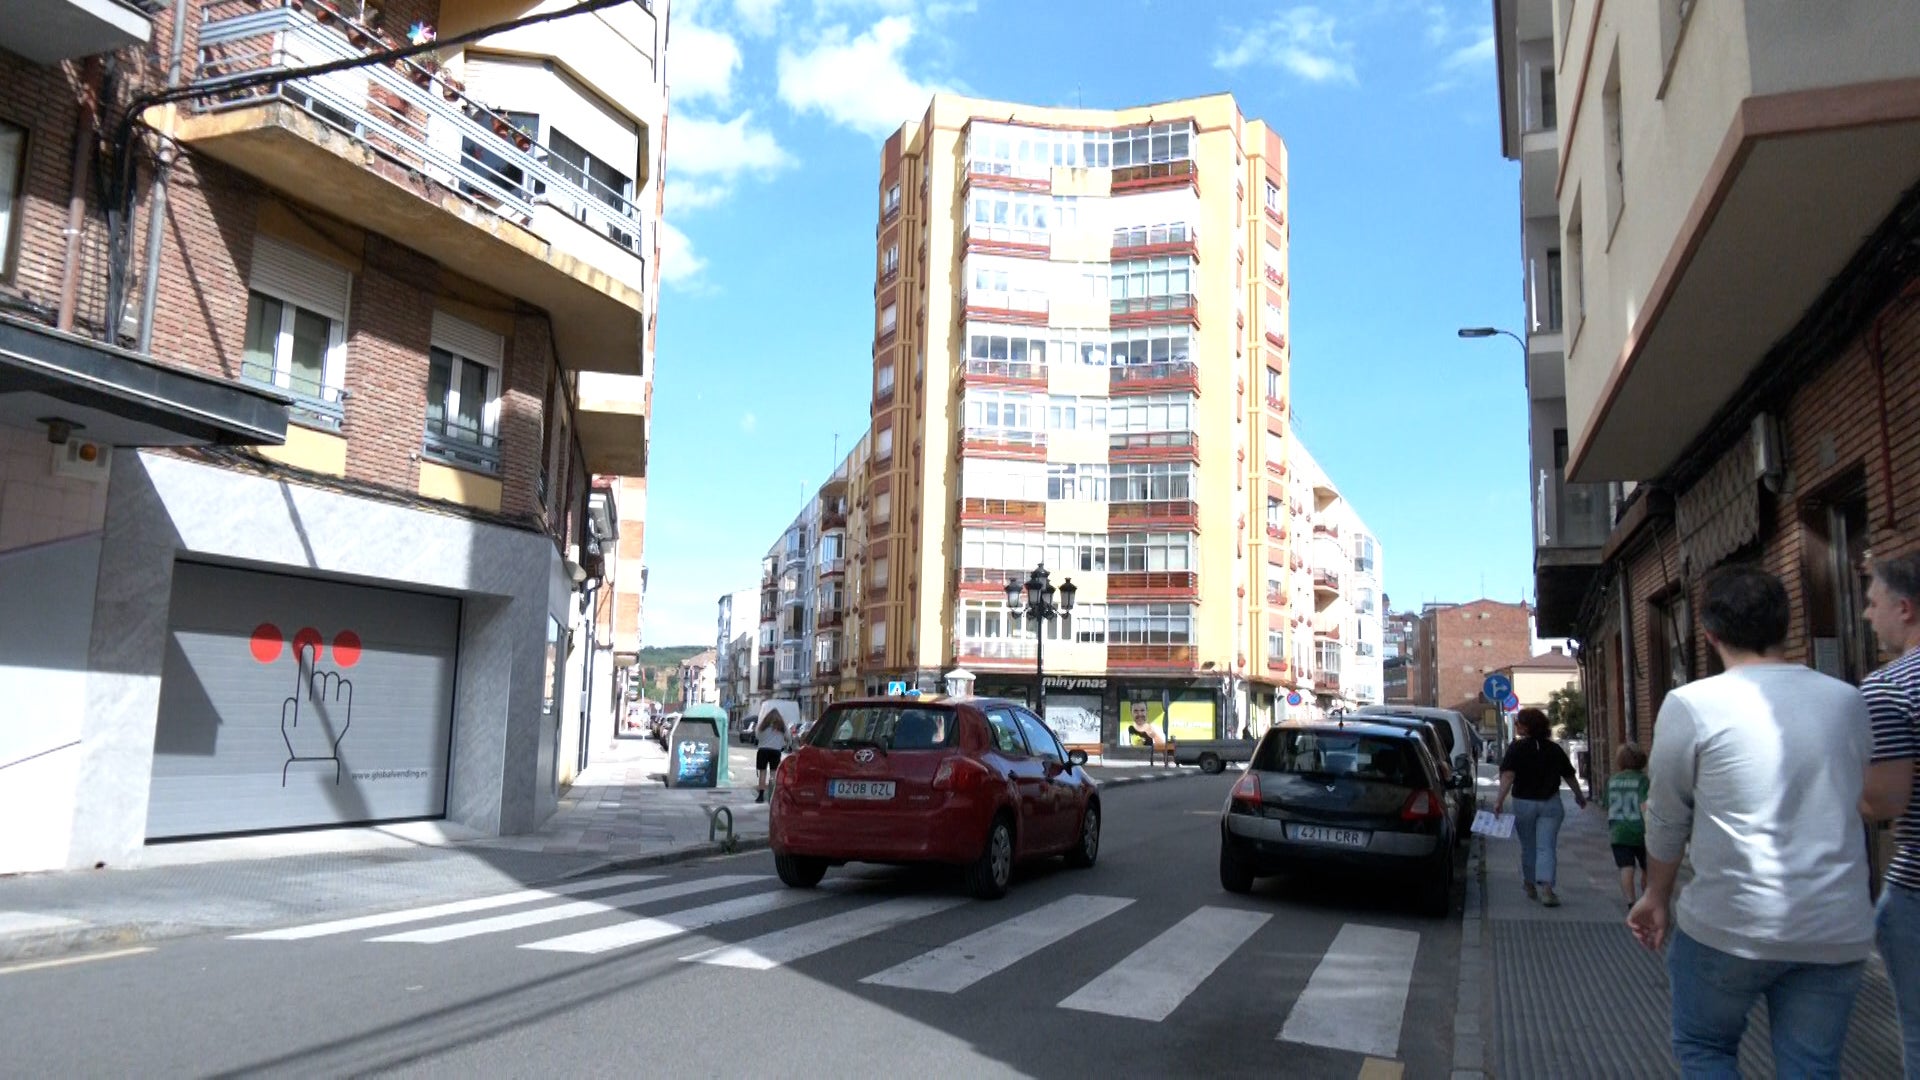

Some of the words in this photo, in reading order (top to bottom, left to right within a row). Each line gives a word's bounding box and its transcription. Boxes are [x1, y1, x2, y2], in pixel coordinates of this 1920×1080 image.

[837, 783, 867, 794] 0208
[870, 783, 892, 796] GZL
[1608, 791, 1641, 820] 20
[1300, 826, 1330, 840] 4211
[1335, 831, 1360, 843] CRR
